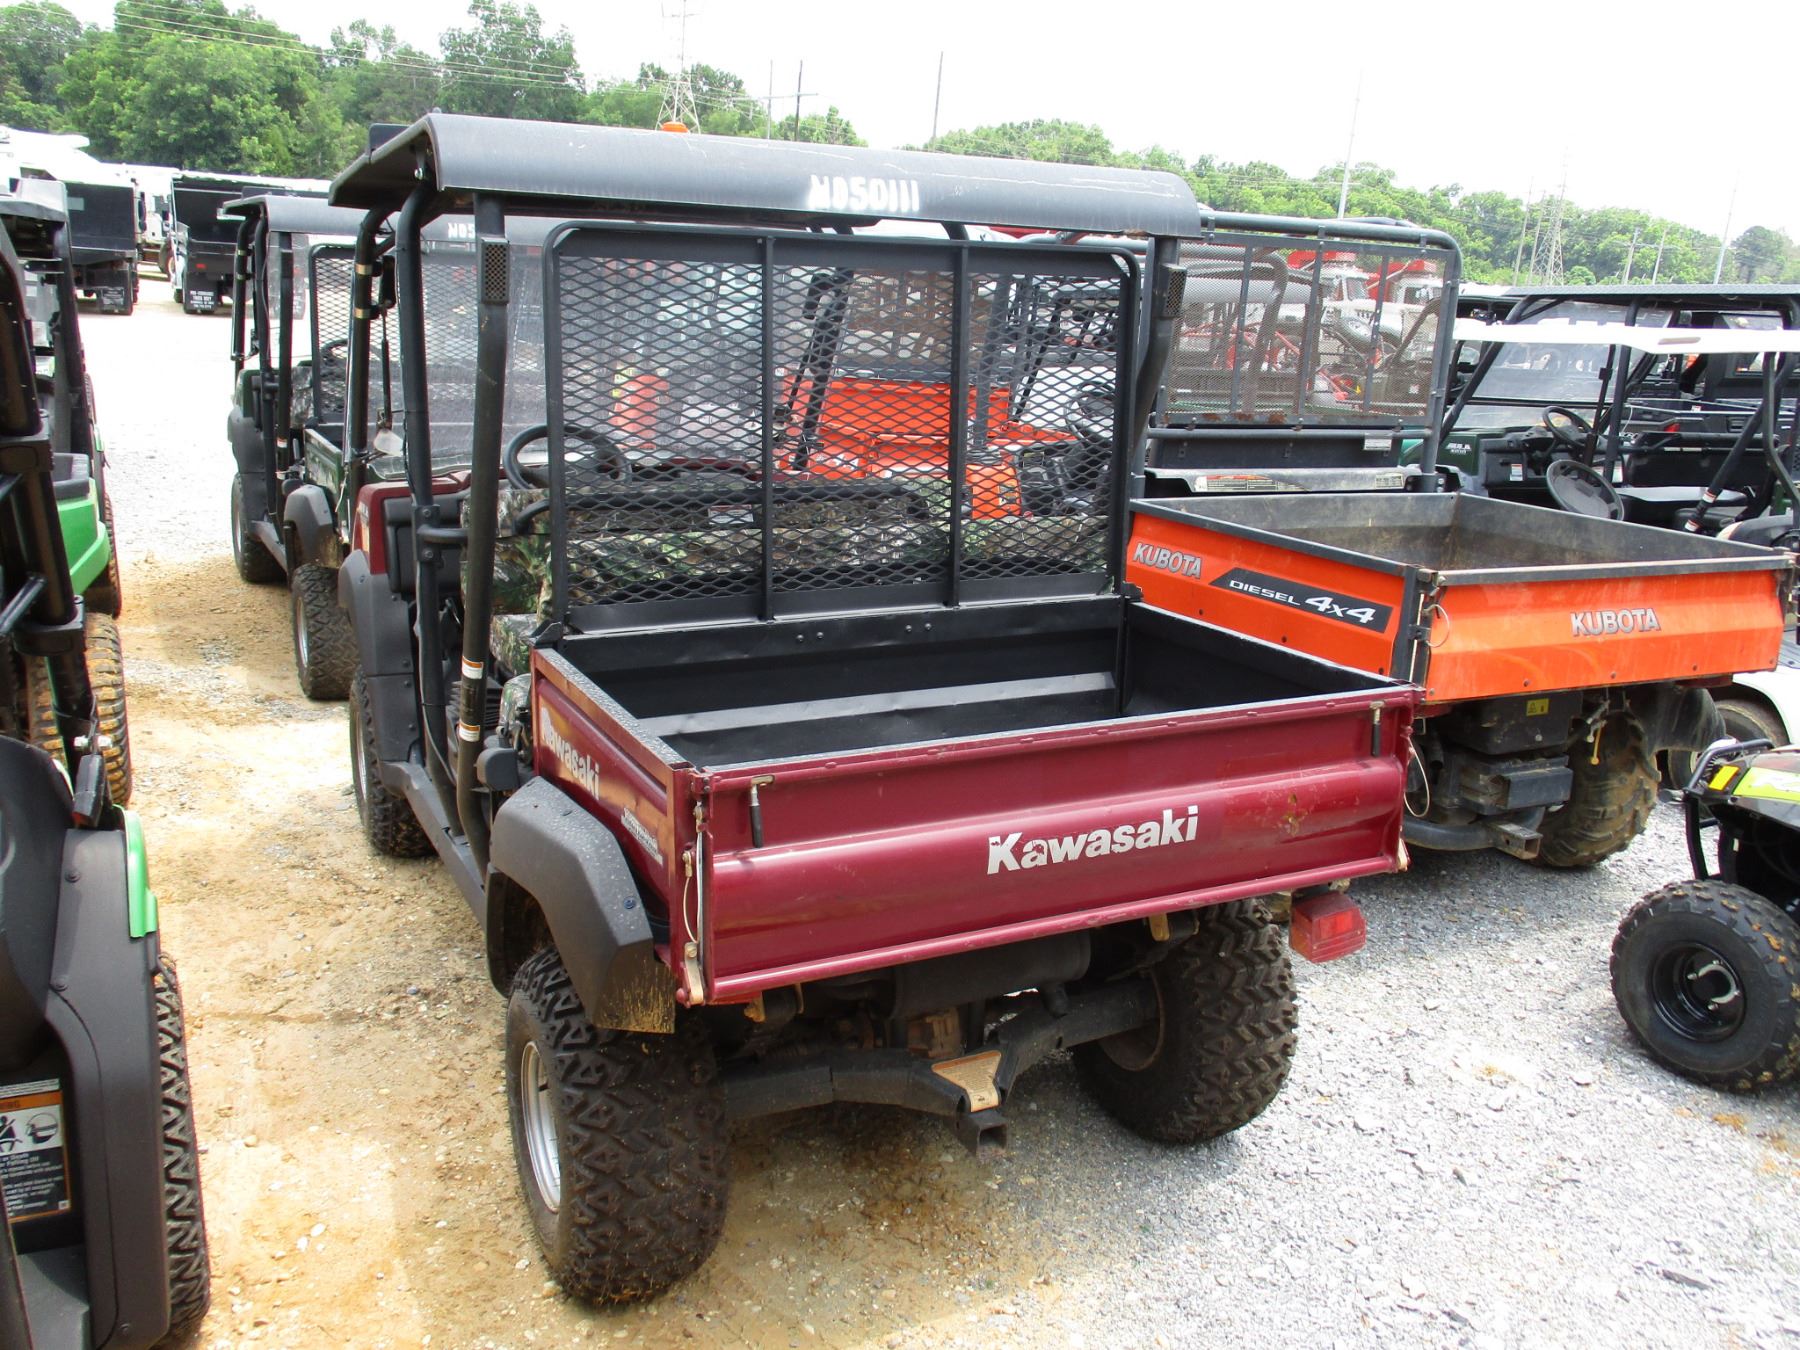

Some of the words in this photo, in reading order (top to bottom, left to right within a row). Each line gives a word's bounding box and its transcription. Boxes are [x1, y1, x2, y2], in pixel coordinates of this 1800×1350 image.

[1133, 542, 1202, 578] KUBOTA
[1229, 580, 1301, 606] DIESEL
[1305, 596, 1374, 624] 4x4
[1570, 607, 1661, 637] KUBOTA
[987, 805, 1199, 875] Kawasaki
